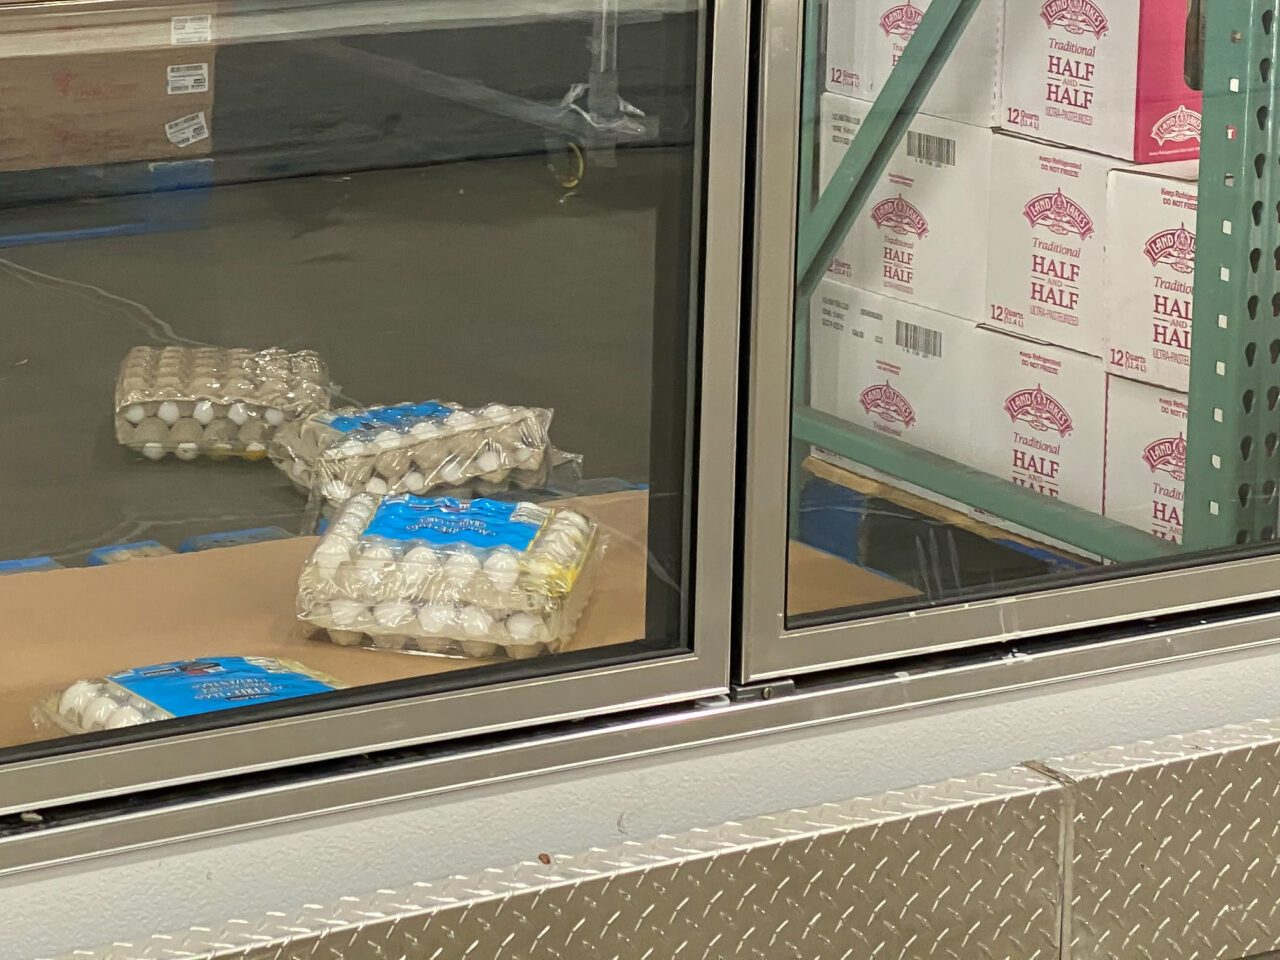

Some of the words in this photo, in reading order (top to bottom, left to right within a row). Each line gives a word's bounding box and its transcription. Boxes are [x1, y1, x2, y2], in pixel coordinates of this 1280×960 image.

[1082, 2, 1102, 27] LAKES
[1049, 38, 1096, 57] Traditional
[831, 68, 841, 83] 12
[1048, 55, 1095, 81] HALF
[1062, 78, 1078, 87] AND
[1046, 83, 1093, 109] HALF
[1007, 107, 1019, 124] 12
[1021, 110, 1039, 121] Quarts
[1031, 198, 1050, 215] LAND
[1067, 204, 1087, 228] LAKES
[1033, 237, 1081, 258] Traditional
[1151, 235, 1173, 253] LAND
[884, 247, 914, 265] HALF
[884, 265, 914, 284] HALF
[1032, 254, 1080, 282] HALF
[1047, 278, 1063, 287] AND
[1031, 282, 1079, 310] HALF
[991, 304, 1003, 322] 12
[1004, 307, 1024, 320] Quarts
[1170, 320, 1187, 329] AND
[1111, 349, 1123, 366] 12
[1125, 351, 1146, 363] Quarts
[1012, 393, 1031, 410] LAND
[1046, 400, 1065, 425] LAKES
[1014, 432, 1060, 455] Traditional
[1150, 444, 1171, 461] LAND
[1013, 449, 1059, 478] HALF
[1028, 474, 1042, 483] AND
